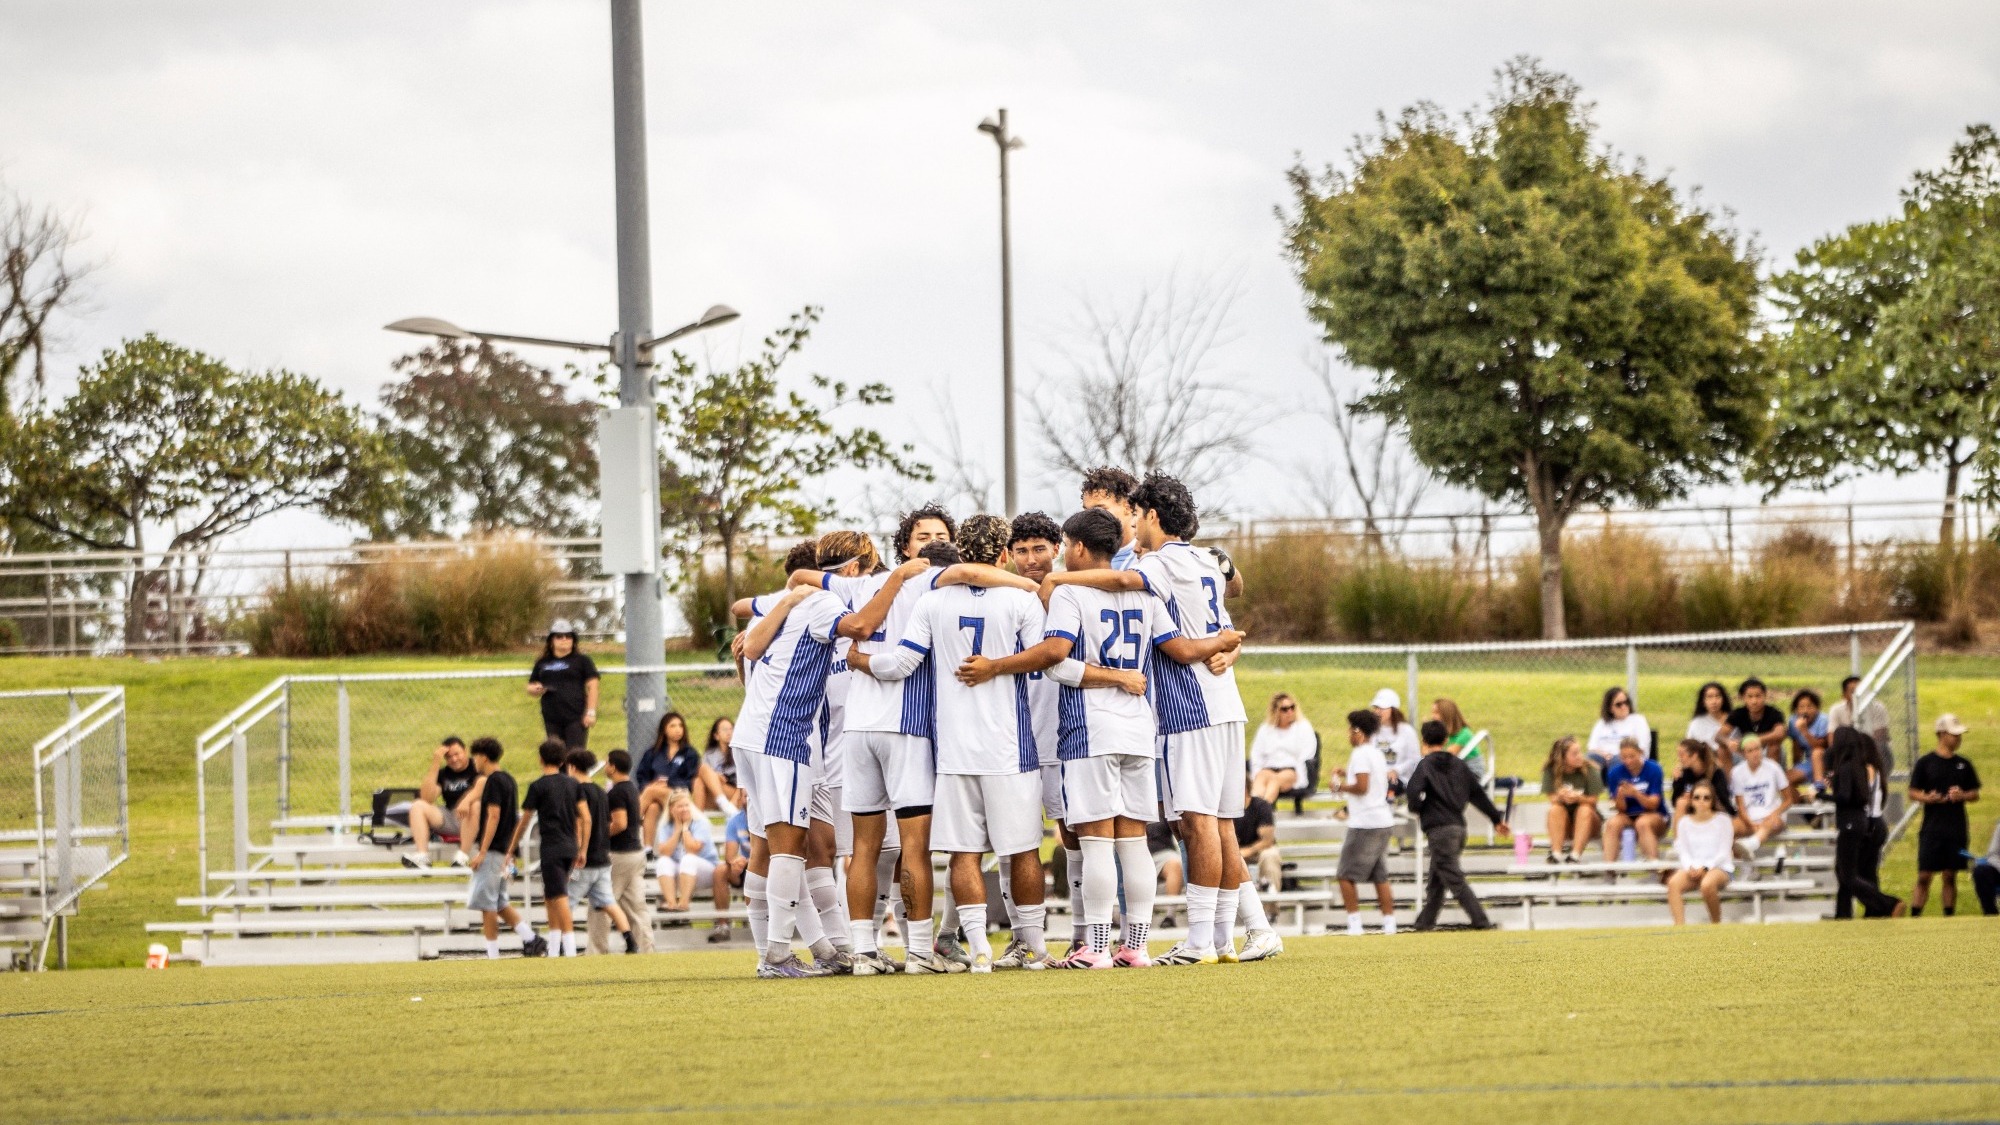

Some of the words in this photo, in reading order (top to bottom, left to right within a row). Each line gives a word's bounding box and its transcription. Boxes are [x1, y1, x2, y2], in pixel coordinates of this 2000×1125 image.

[1201, 576, 1221, 634] 3
[959, 615, 985, 656] 7
[1100, 609, 1144, 669] 25
